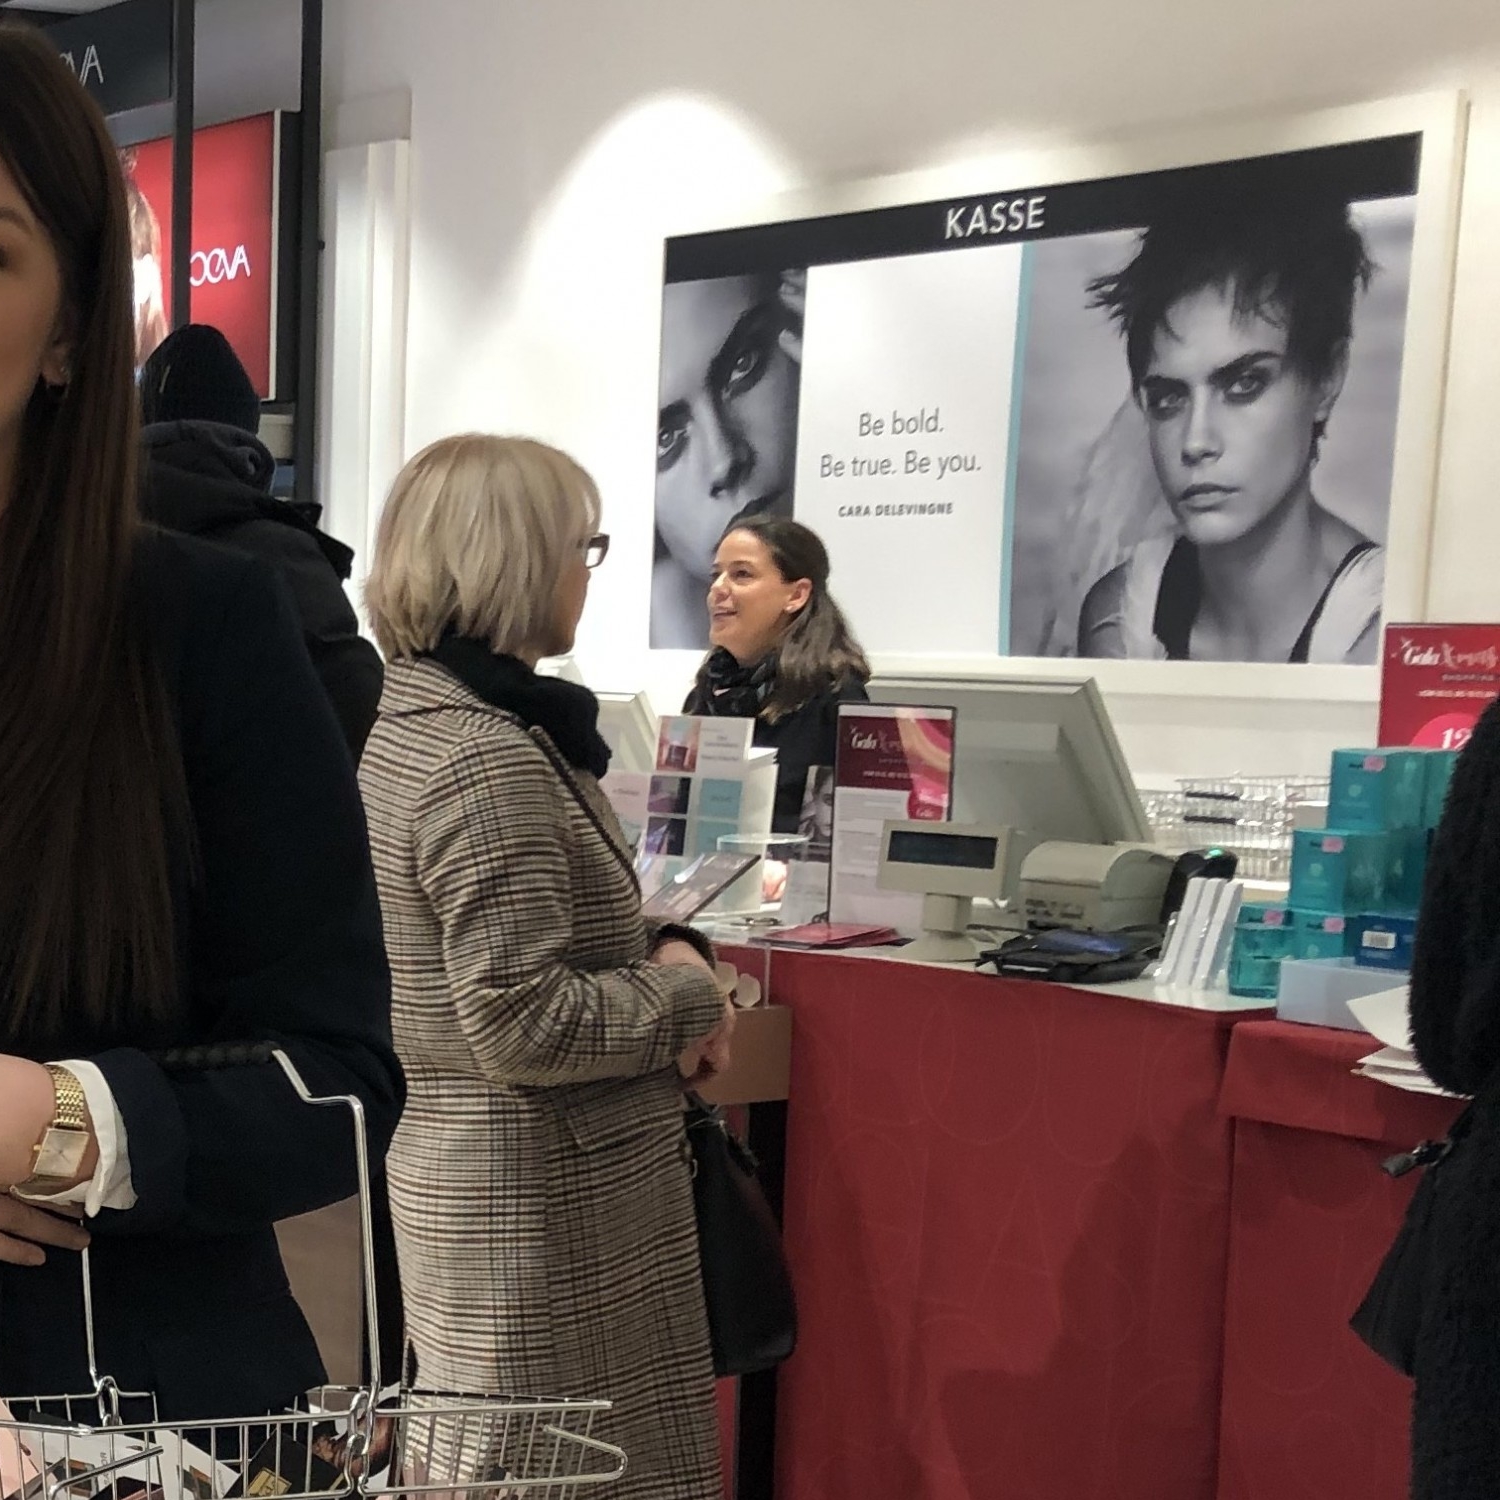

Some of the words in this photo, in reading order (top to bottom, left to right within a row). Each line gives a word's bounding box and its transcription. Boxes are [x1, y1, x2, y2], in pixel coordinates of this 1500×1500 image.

[944, 195, 1047, 240] KASSE
[858, 412, 886, 437] Be
[891, 406, 945, 436] bold.
[819, 453, 846, 479] Be
[851, 455, 897, 477] true.
[904, 449, 931, 475] Be
[936, 452, 982, 481] you.
[838, 504, 871, 518] CARA
[874, 501, 954, 518] DELEVINGNE
